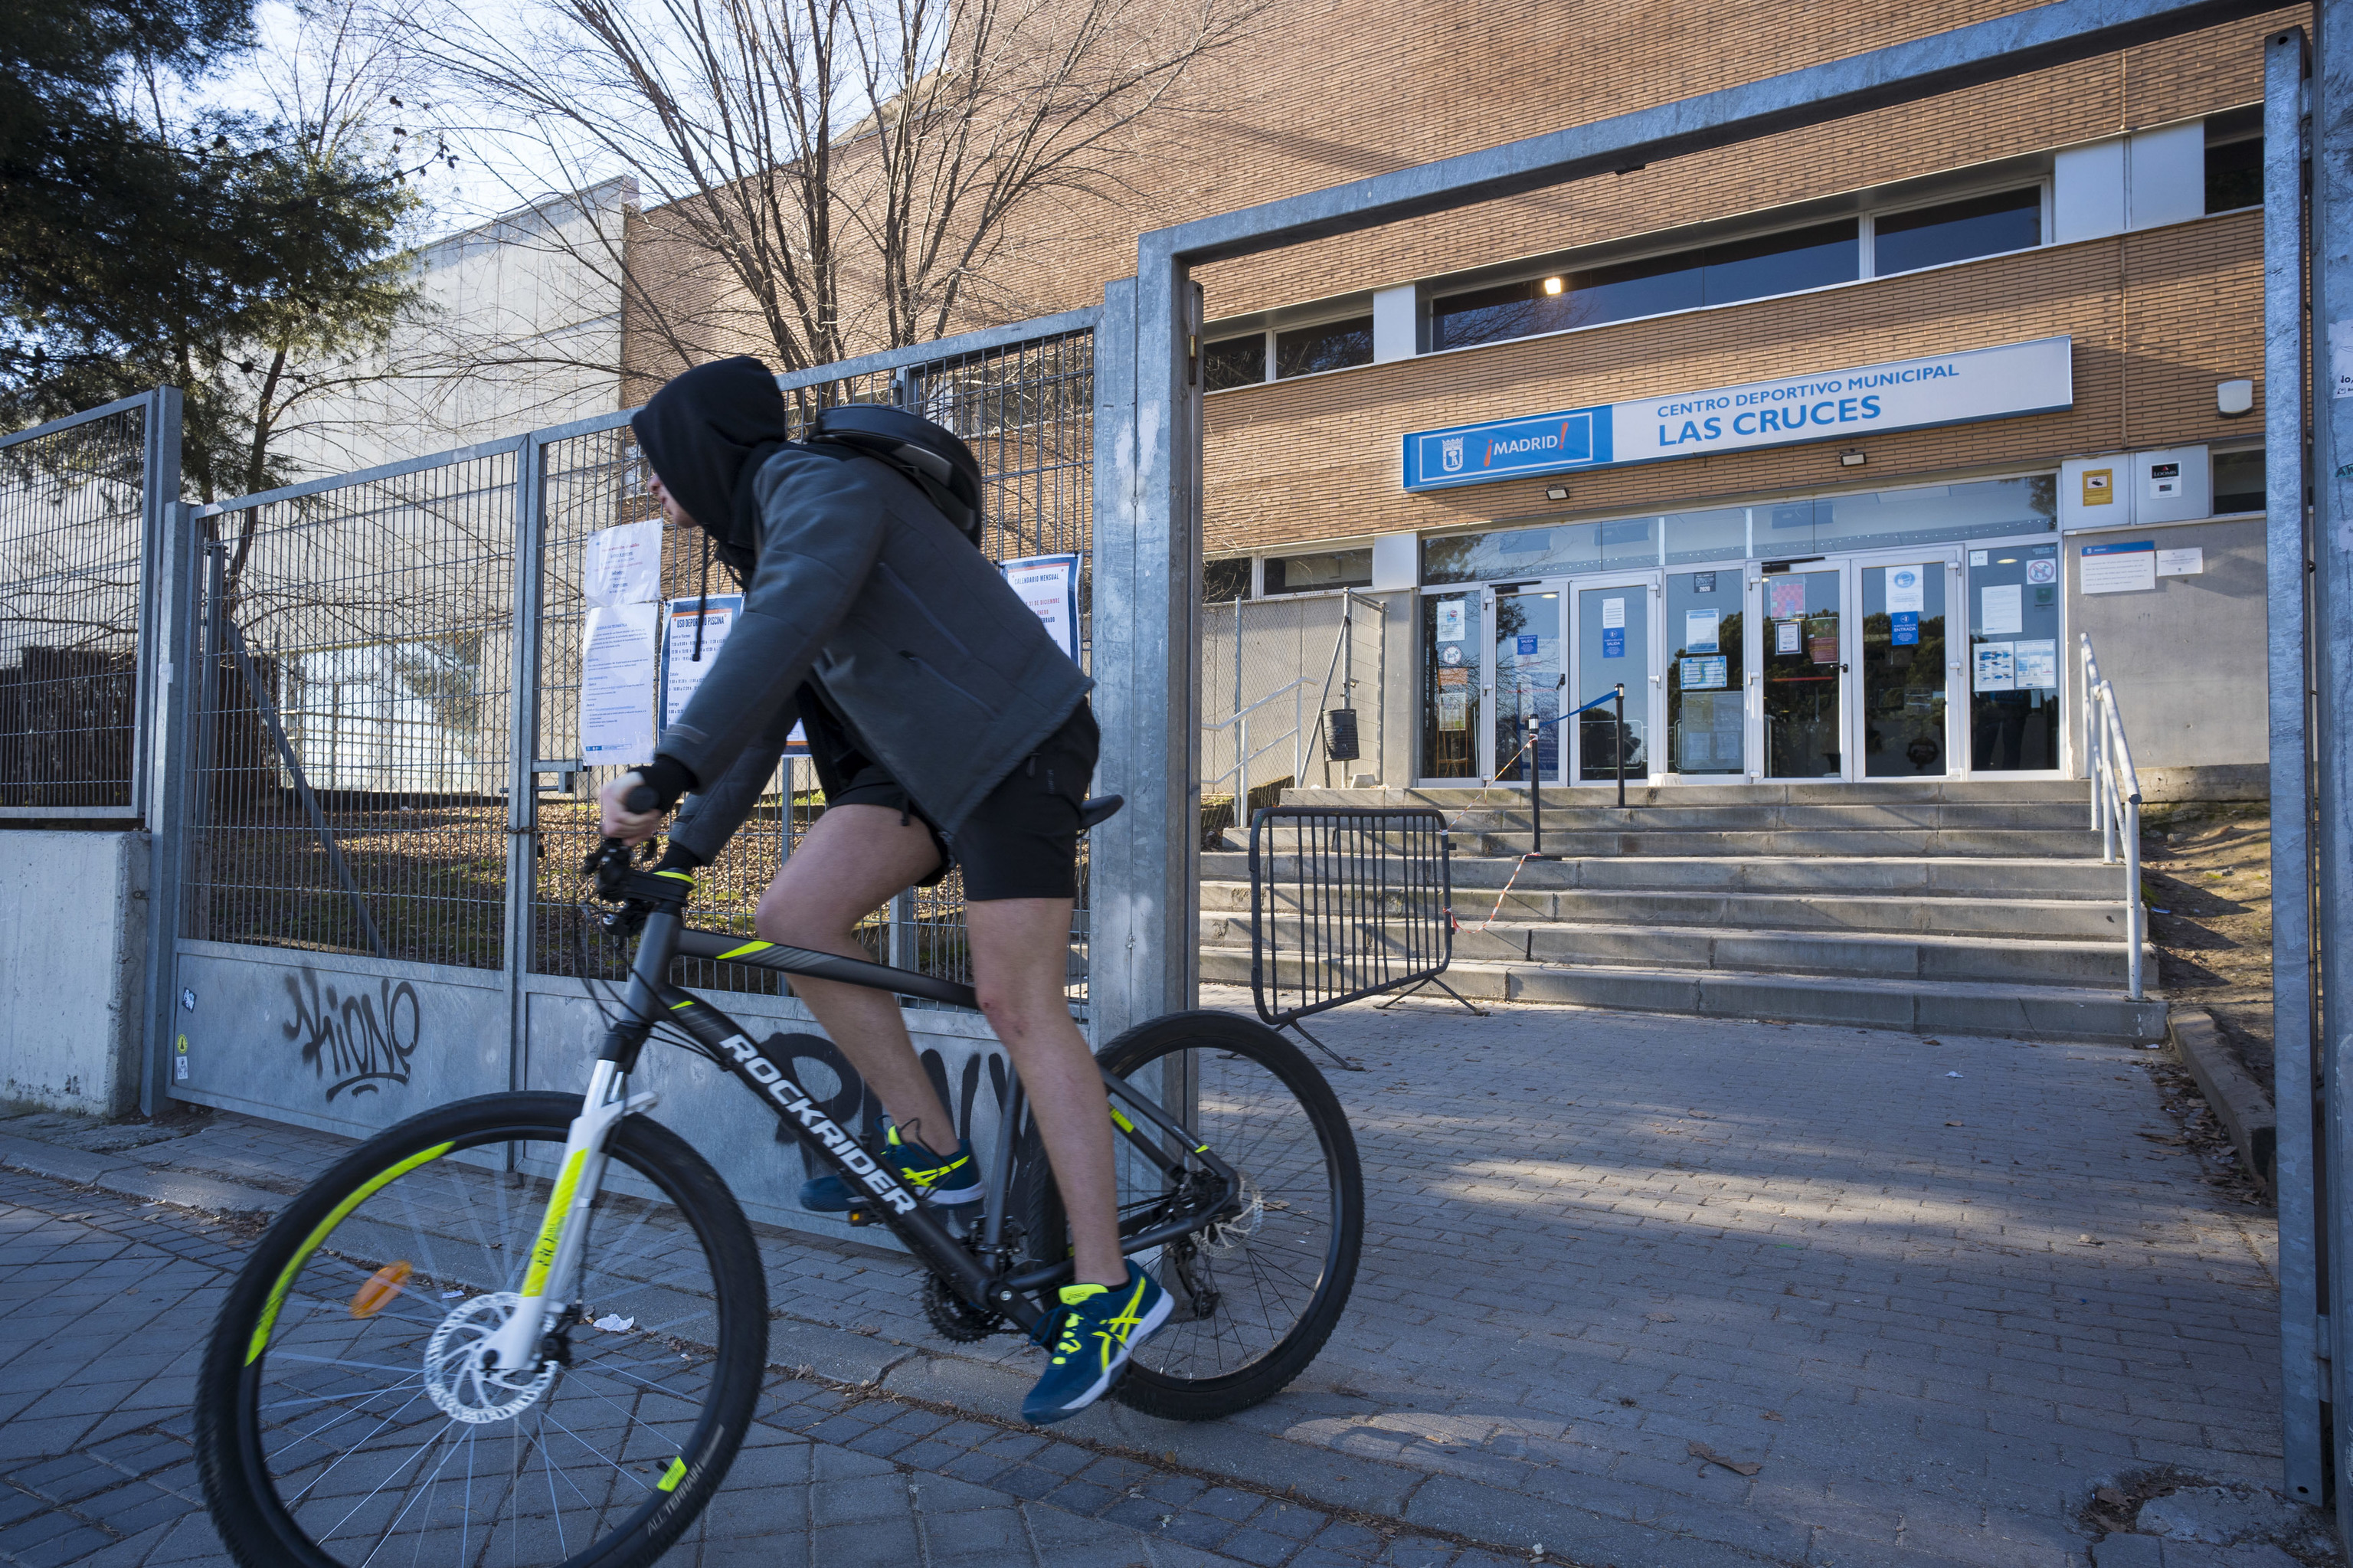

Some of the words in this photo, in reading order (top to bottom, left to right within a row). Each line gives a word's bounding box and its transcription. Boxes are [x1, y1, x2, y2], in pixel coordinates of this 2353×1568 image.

[1658, 397, 1730, 417] CENTRO
[1736, 380, 1842, 407] DEPORTIVO
[1848, 364, 1959, 391] MUNICIPAL
[1659, 417, 1722, 447] LAS
[1733, 394, 1881, 436] CRUCES
[1015, 575, 1039, 584] CALENDARIO
[1040, 573, 1059, 582] MENSUAL
[708, 616, 725, 626] PISCINA
[720, 1033, 918, 1216] ROCKRIDER
[647, 1512, 667, 1537] ALL
